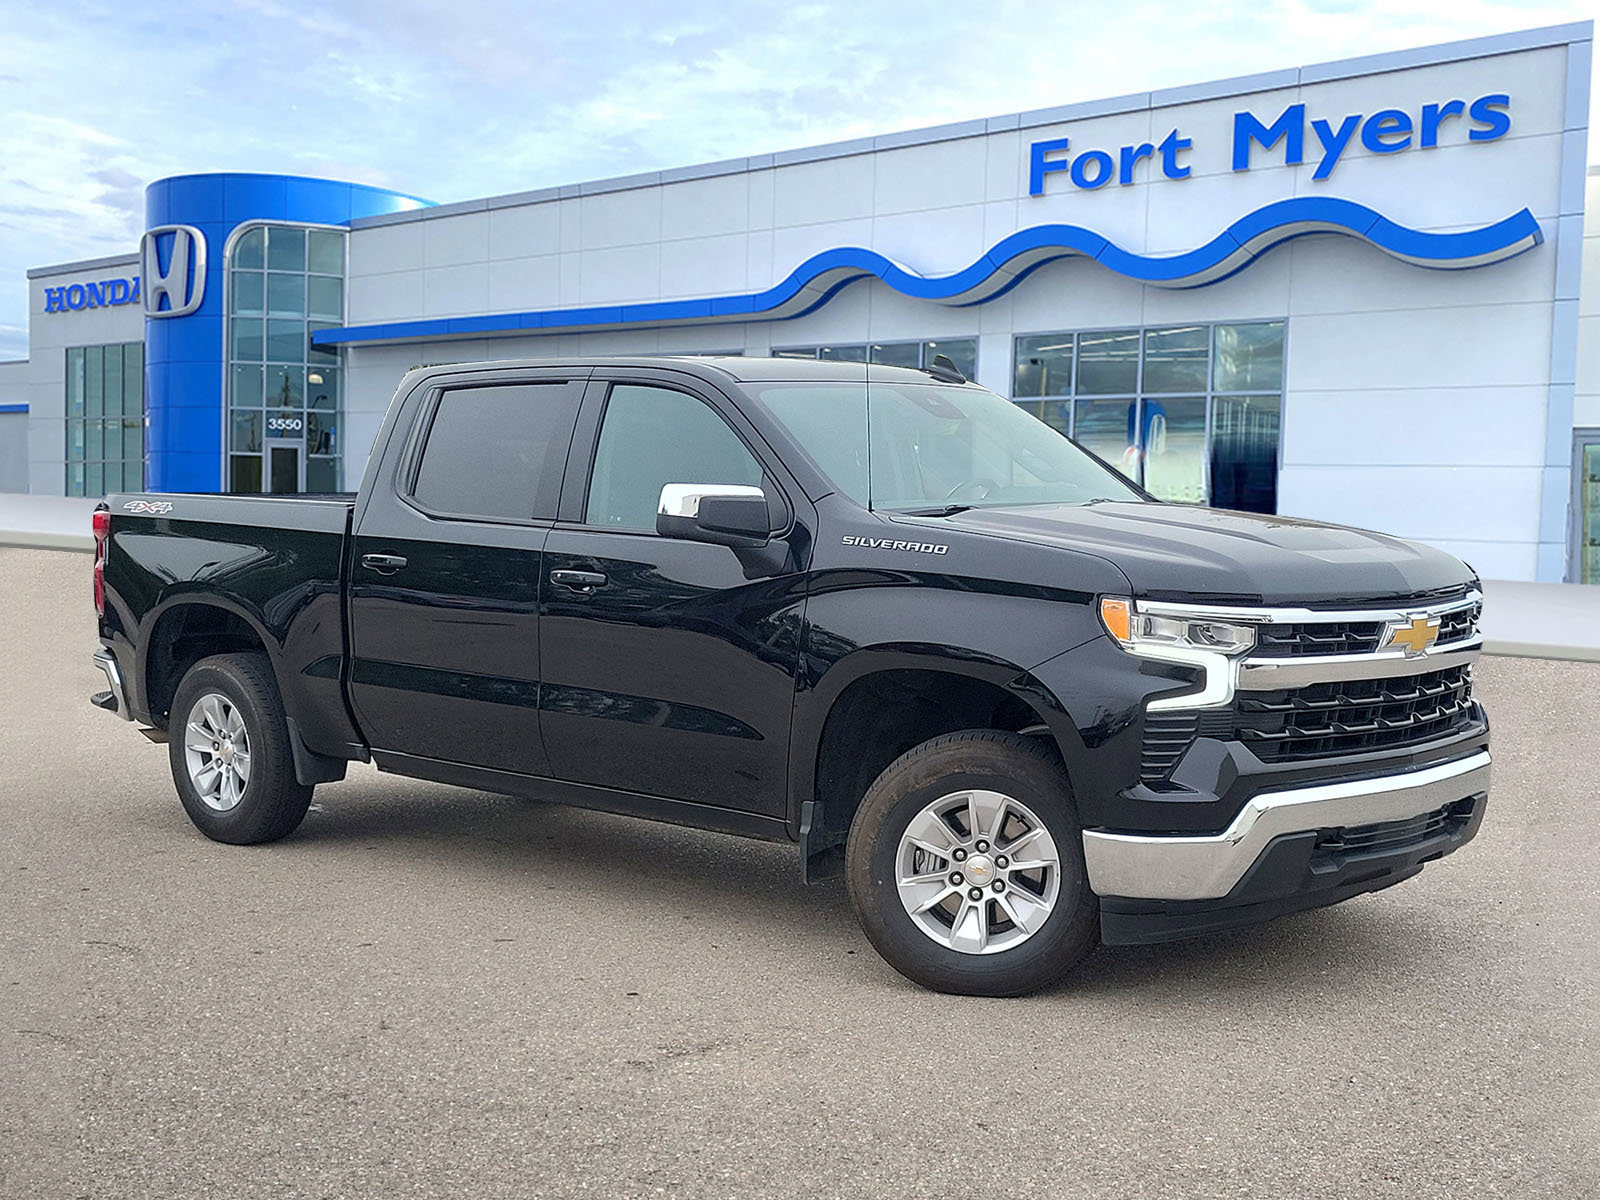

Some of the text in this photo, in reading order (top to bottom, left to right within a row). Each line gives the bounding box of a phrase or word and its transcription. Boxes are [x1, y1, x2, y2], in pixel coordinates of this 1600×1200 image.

[1029, 93, 1511, 196] Fort Myers
[268, 418, 302, 430] 3550
[841, 535, 949, 555] SILVERADO
